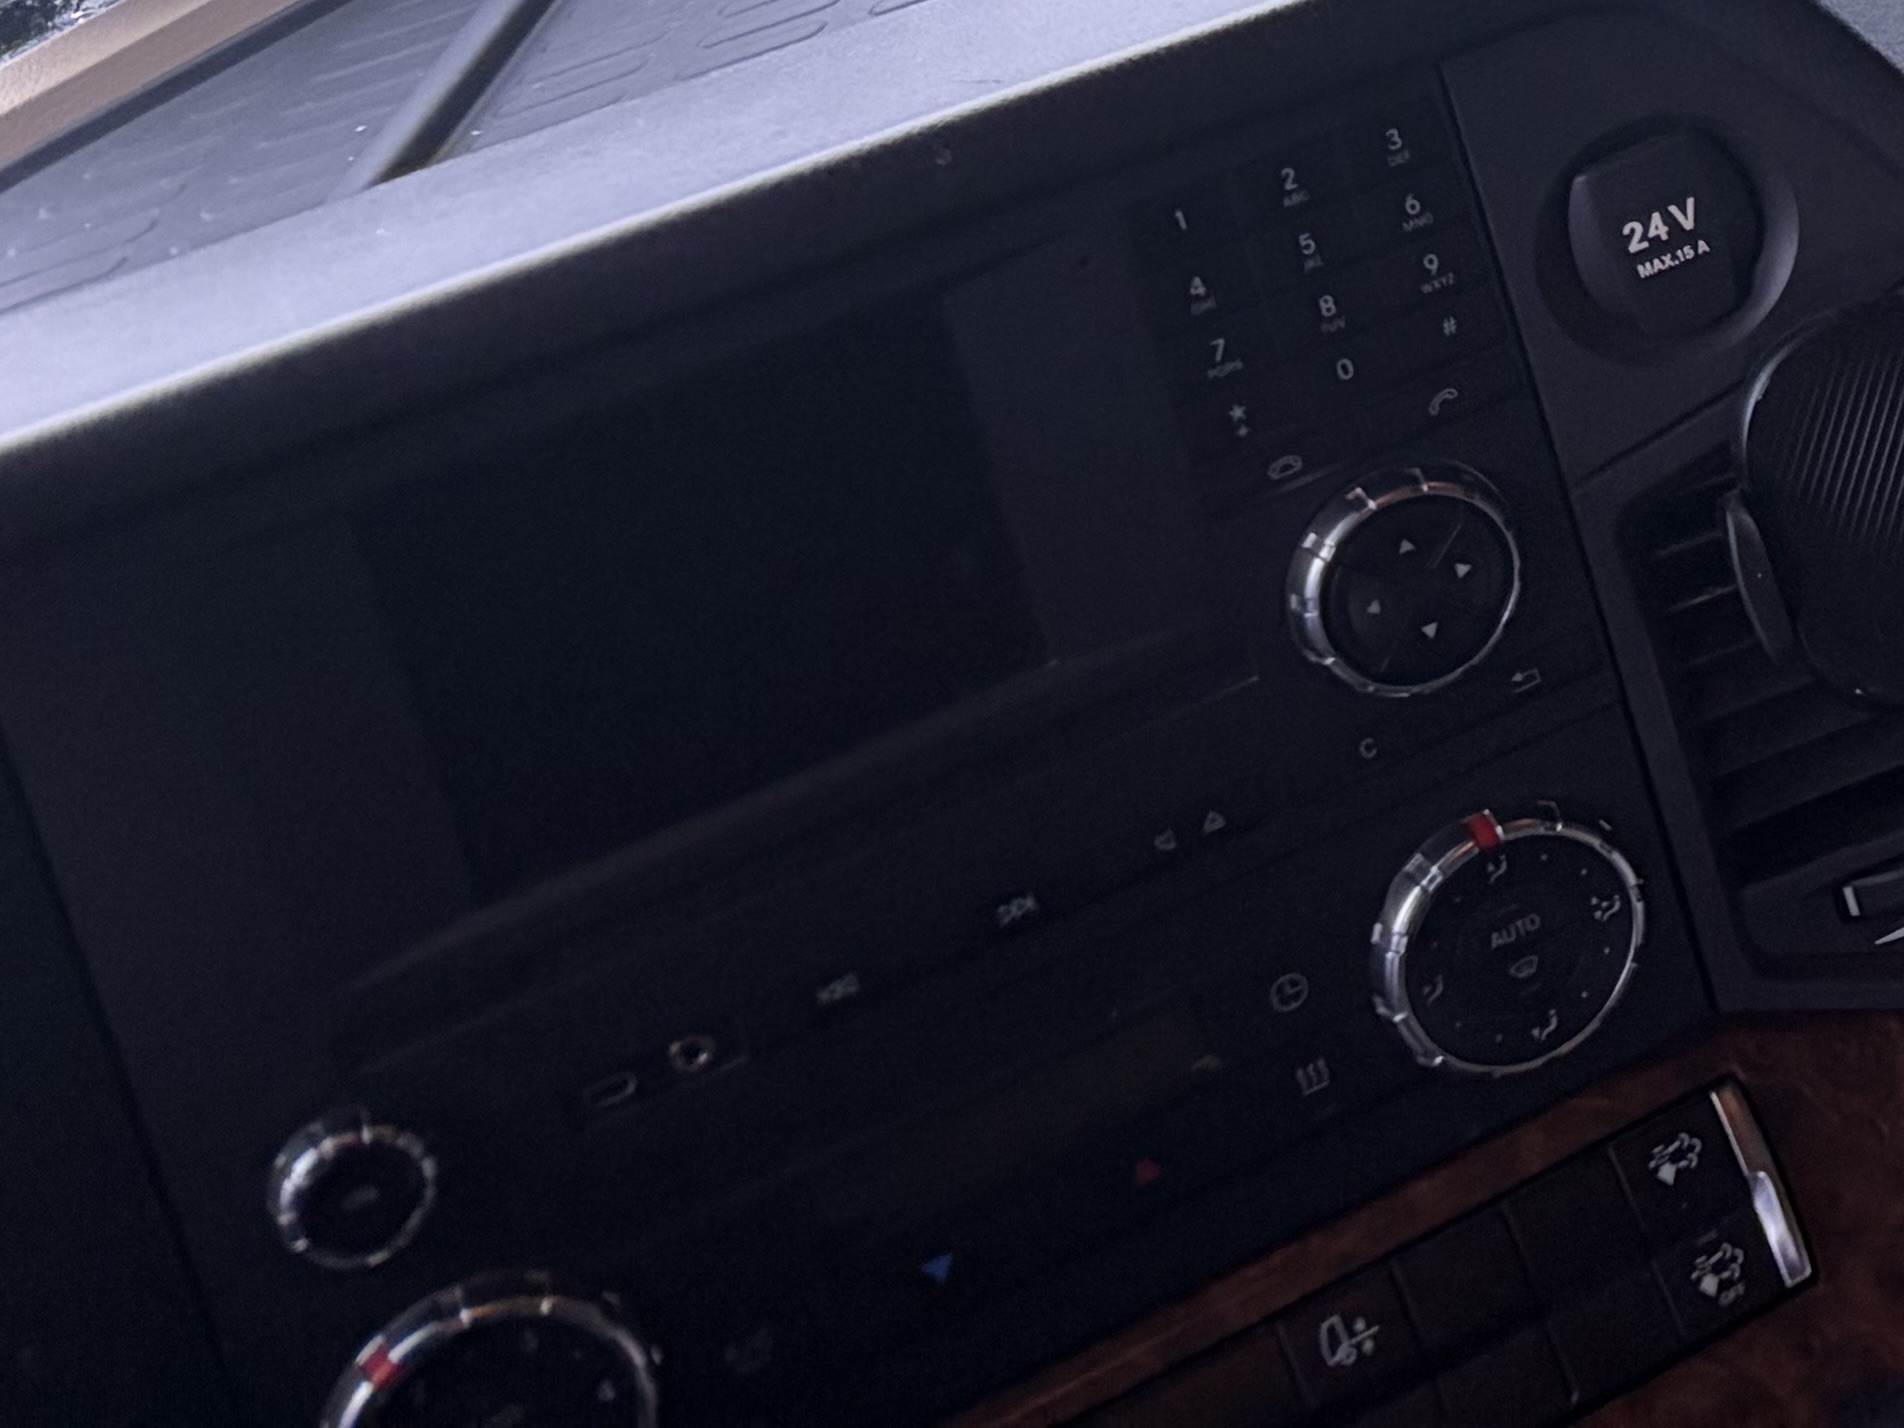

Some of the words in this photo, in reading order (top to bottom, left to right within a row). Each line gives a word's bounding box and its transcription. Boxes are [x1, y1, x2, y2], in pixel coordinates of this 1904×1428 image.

[1385, 128, 1403, 150] 3
[1281, 167, 1299, 190] 2
[1405, 193, 1421, 215] 6
[1174, 210, 1188, 231] 1
[1299, 232, 1316, 255] 5
[1423, 253, 1440, 275] 9
[1190, 276, 1207, 295] 4
[1318, 294, 1337, 317] 8
[1210, 338, 1226, 362] 7
[1336, 358, 1354, 380] 0
[1360, 737, 1378, 759] C
[1491, 913, 1541, 950] AUTO
